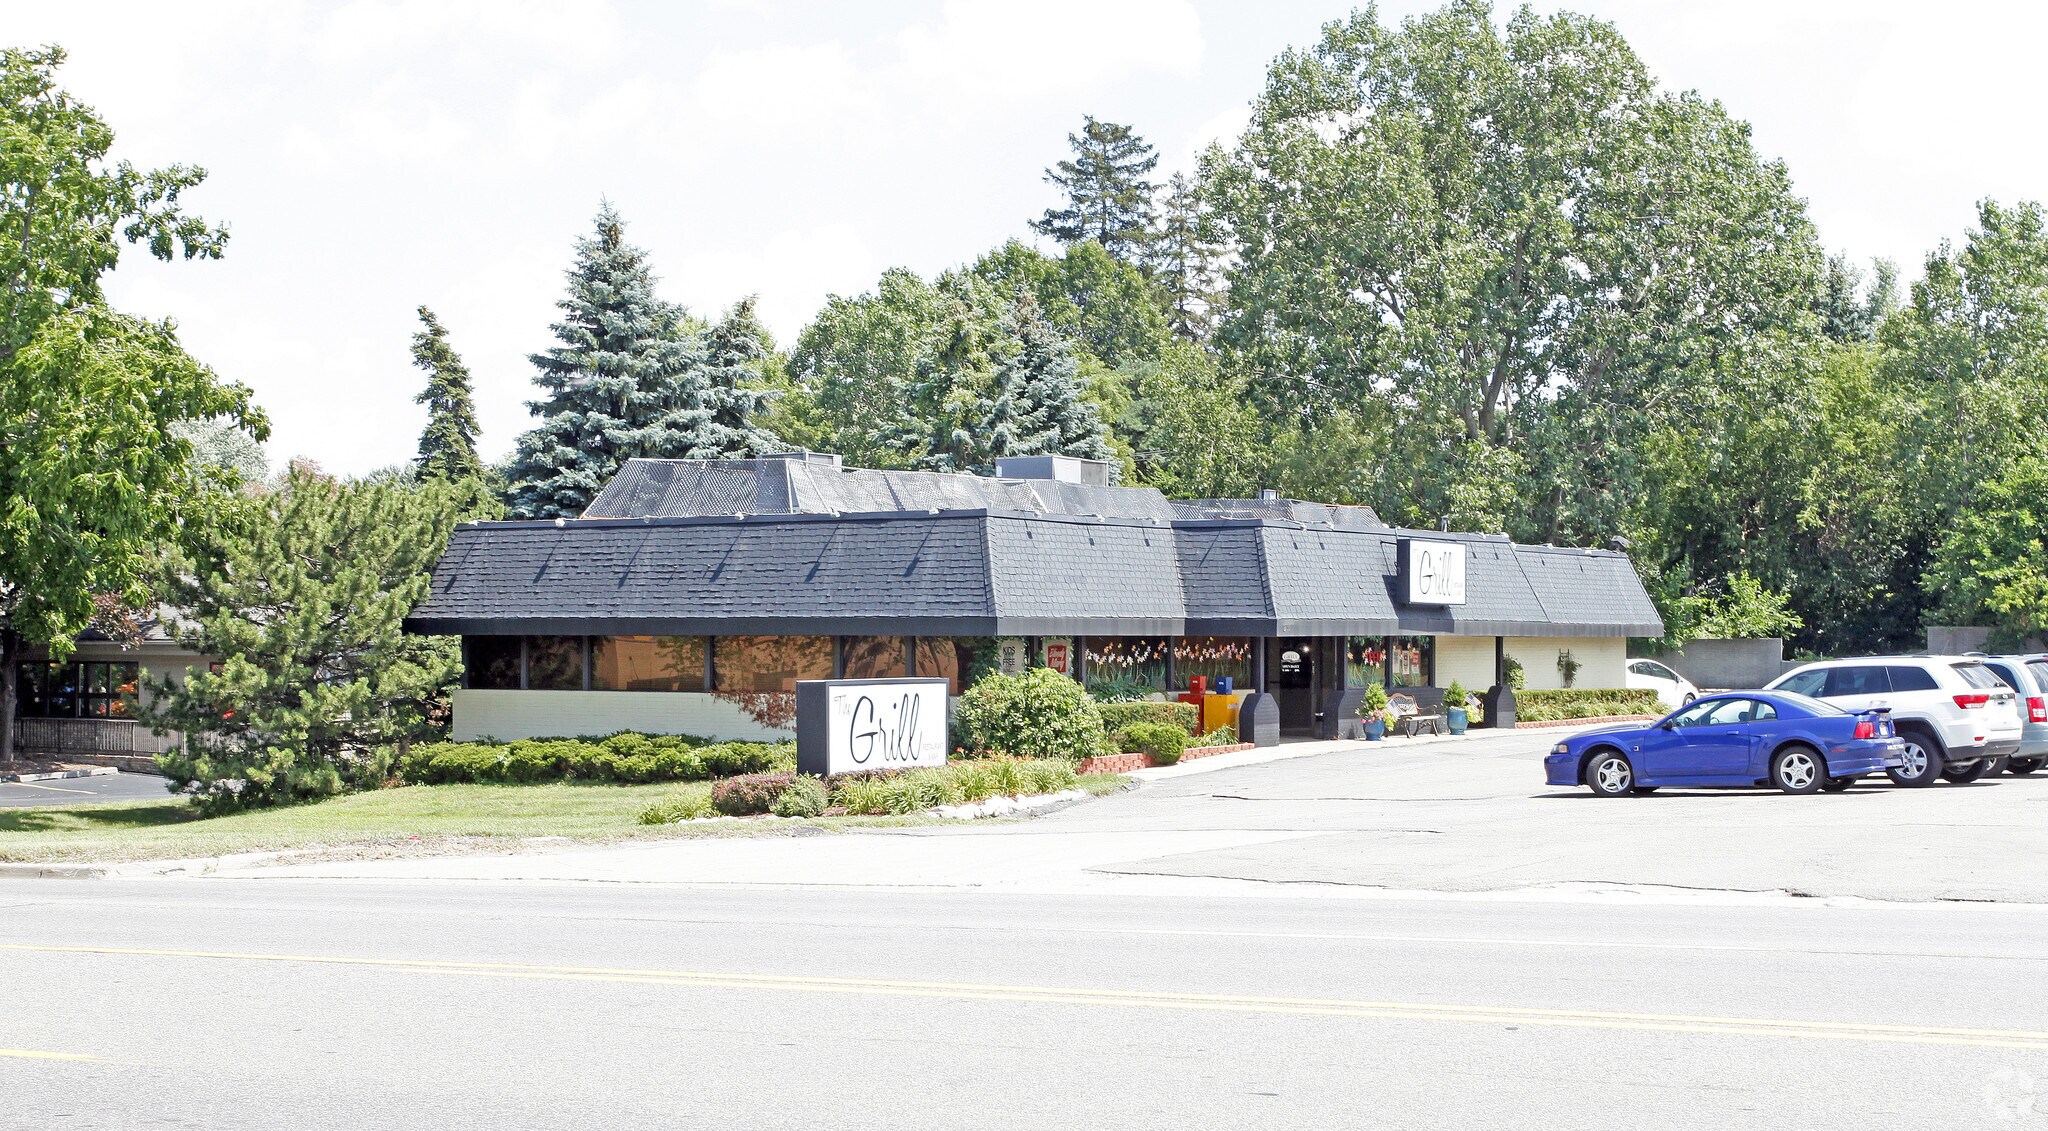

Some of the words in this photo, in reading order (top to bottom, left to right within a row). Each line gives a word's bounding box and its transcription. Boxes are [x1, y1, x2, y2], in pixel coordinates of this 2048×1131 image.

[1419, 550, 1453, 596] Grill
[1003, 658, 1015, 666] FREE
[850, 693, 922, 764] Grill
